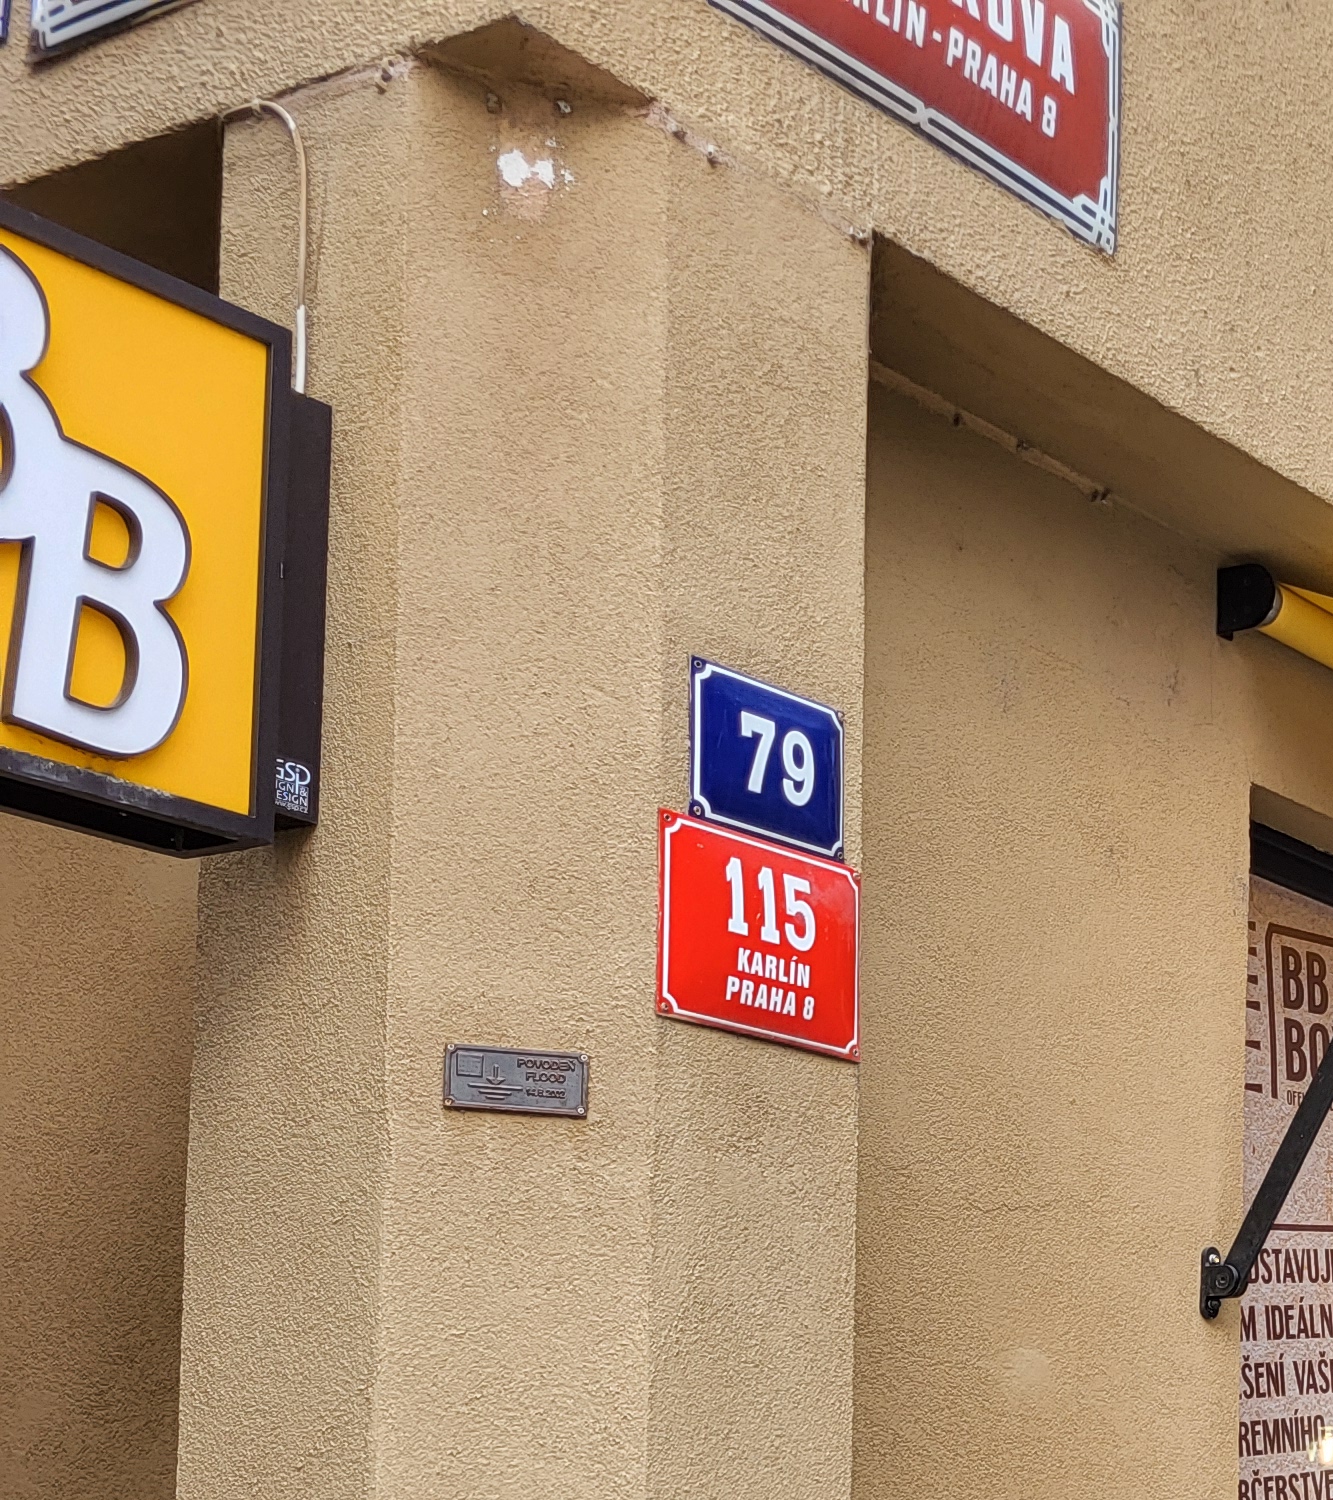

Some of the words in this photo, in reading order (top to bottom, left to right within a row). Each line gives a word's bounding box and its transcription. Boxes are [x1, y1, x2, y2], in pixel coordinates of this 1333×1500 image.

[946, 26, 1033, 123] PRAHA
[1041, 94, 1058, 138] 8
[950, 0, 1076, 95] OVA
[0, 243, 192, 758] B
[740, 710, 815, 807] 79
[725, 856, 817, 952] 115
[725, 975, 797, 1018] PRAHA
[803, 995, 816, 1021] 8
[737, 946, 811, 989] KARLÍN
[1281, 945, 1329, 1015] BB
[525, 1071, 567, 1084] FLOOD
[1240, 1353, 1286, 1400] ŠENÍ
